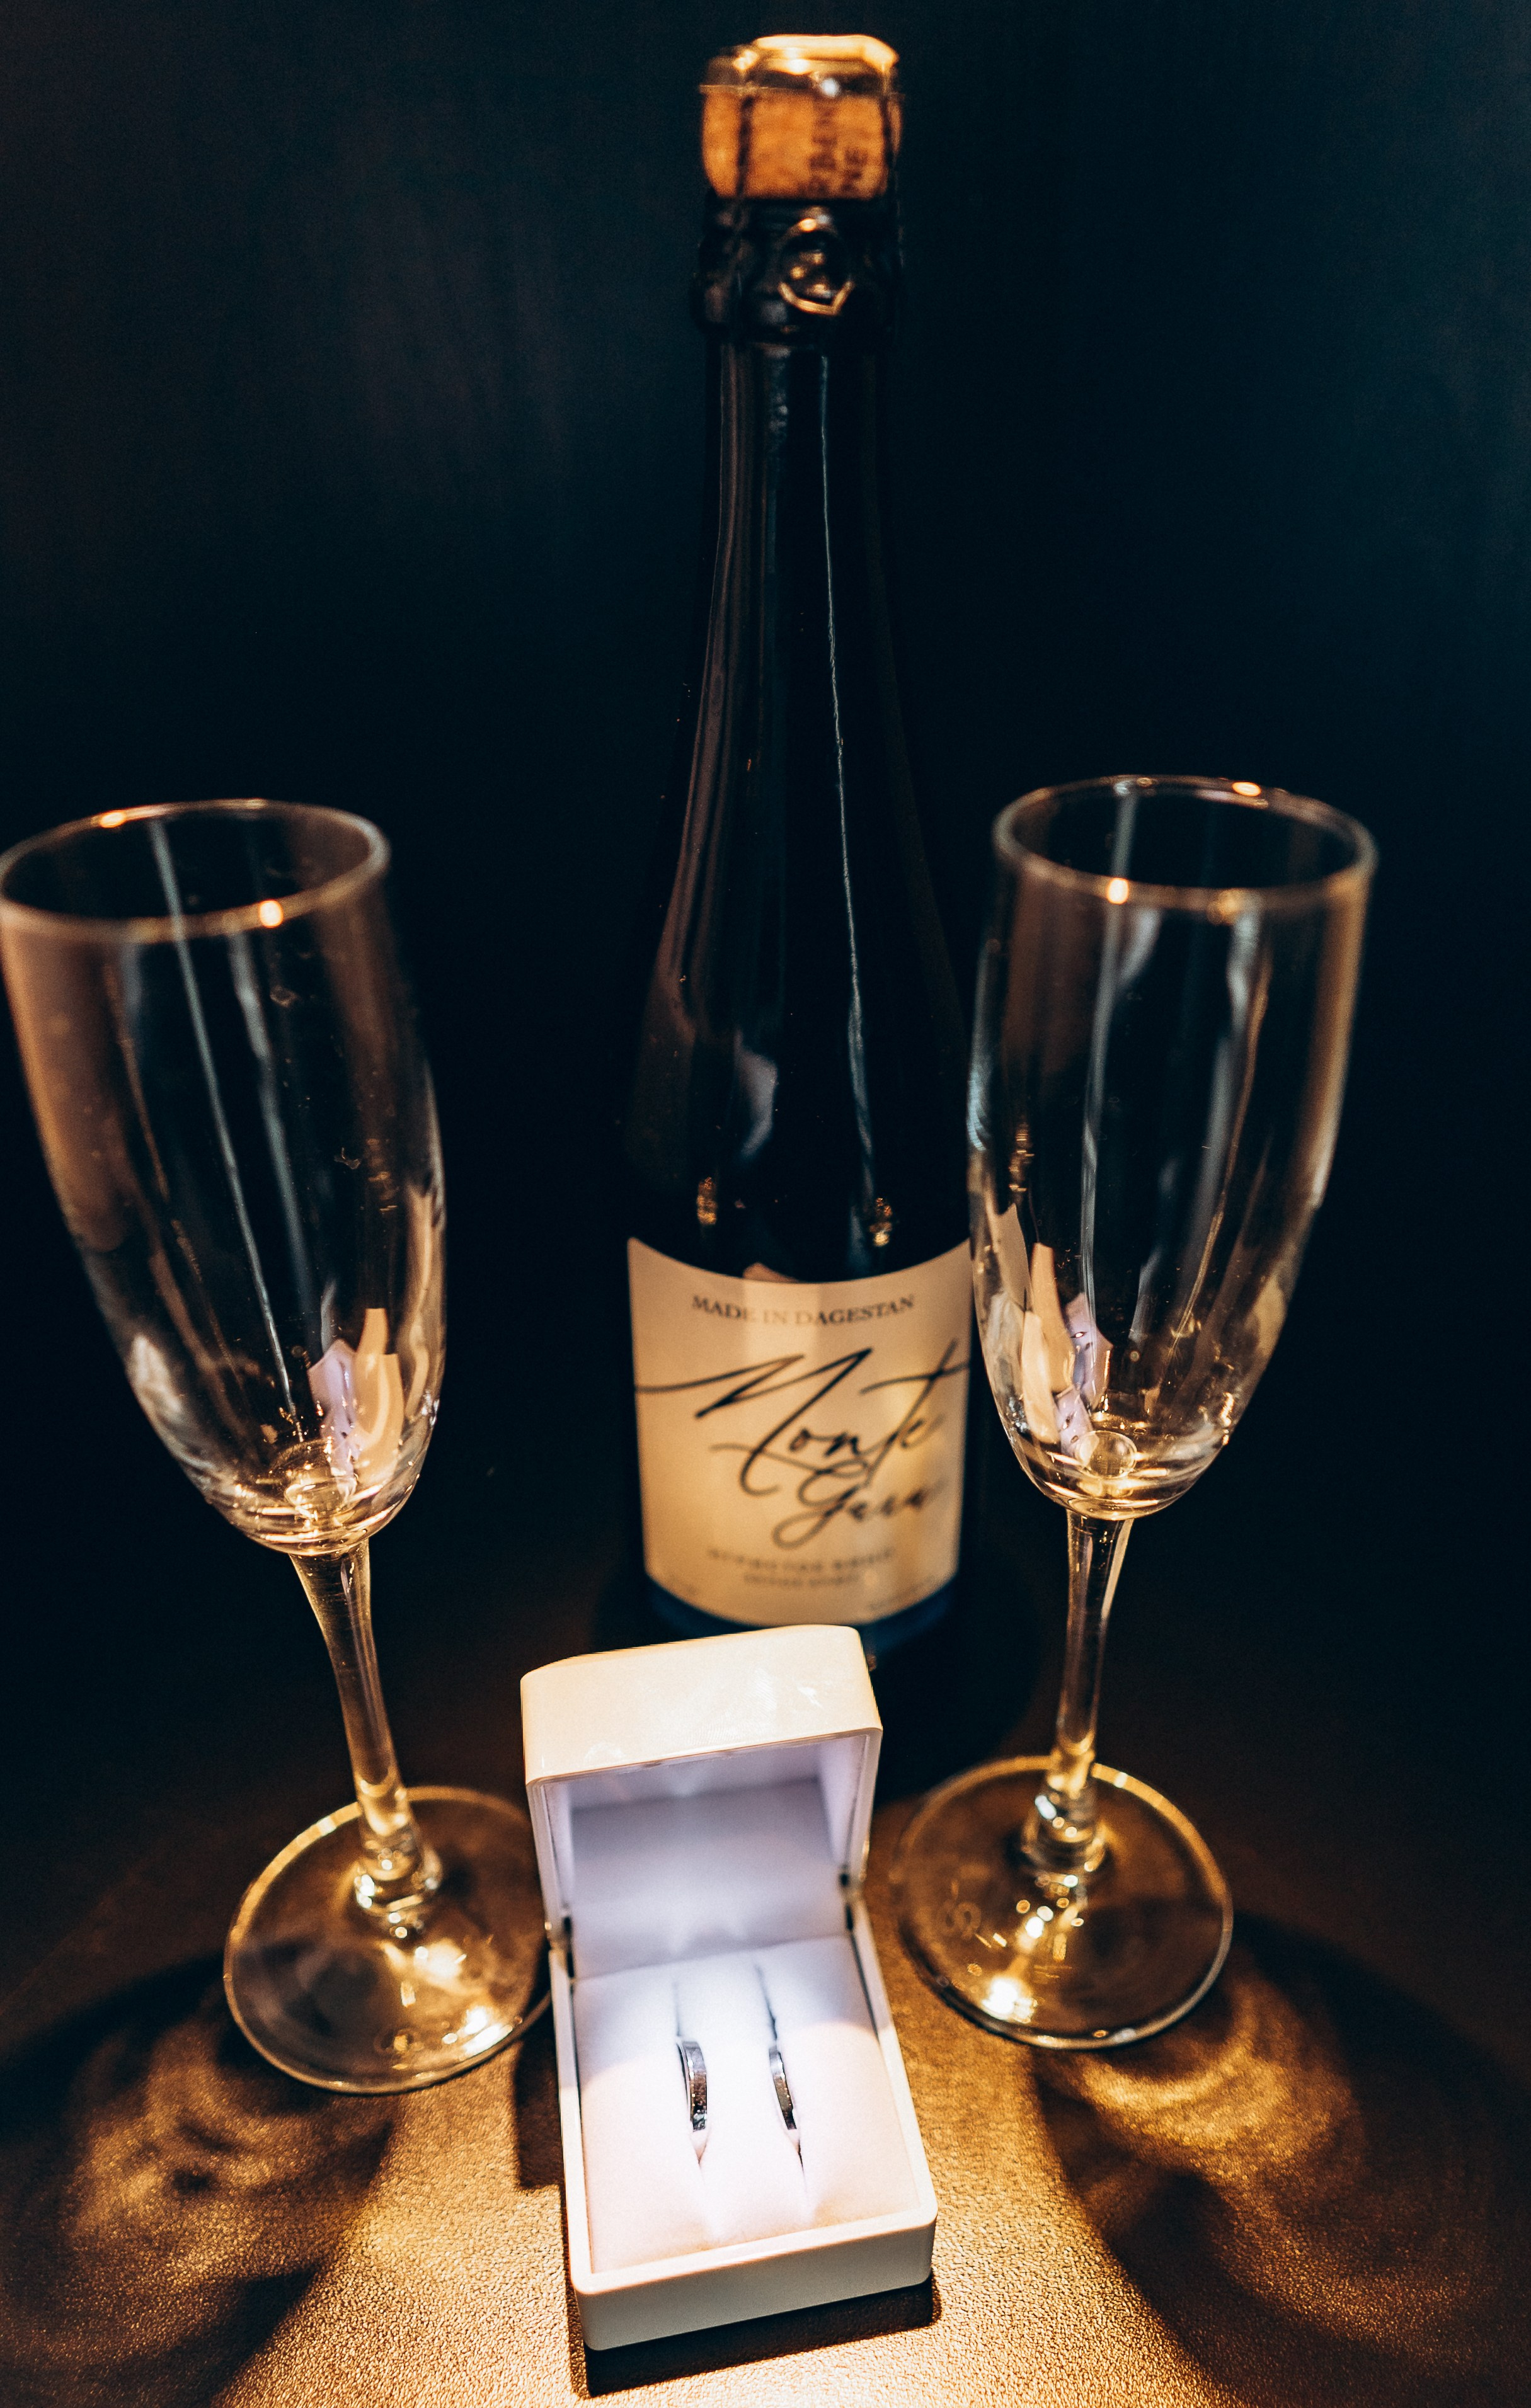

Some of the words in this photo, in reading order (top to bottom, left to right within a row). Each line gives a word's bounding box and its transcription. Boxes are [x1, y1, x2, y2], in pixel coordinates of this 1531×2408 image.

[692, 1294, 755, 1321] MADE
[763, 1308, 788, 1325] IN
[794, 1293, 917, 1327] DAGESTAN
